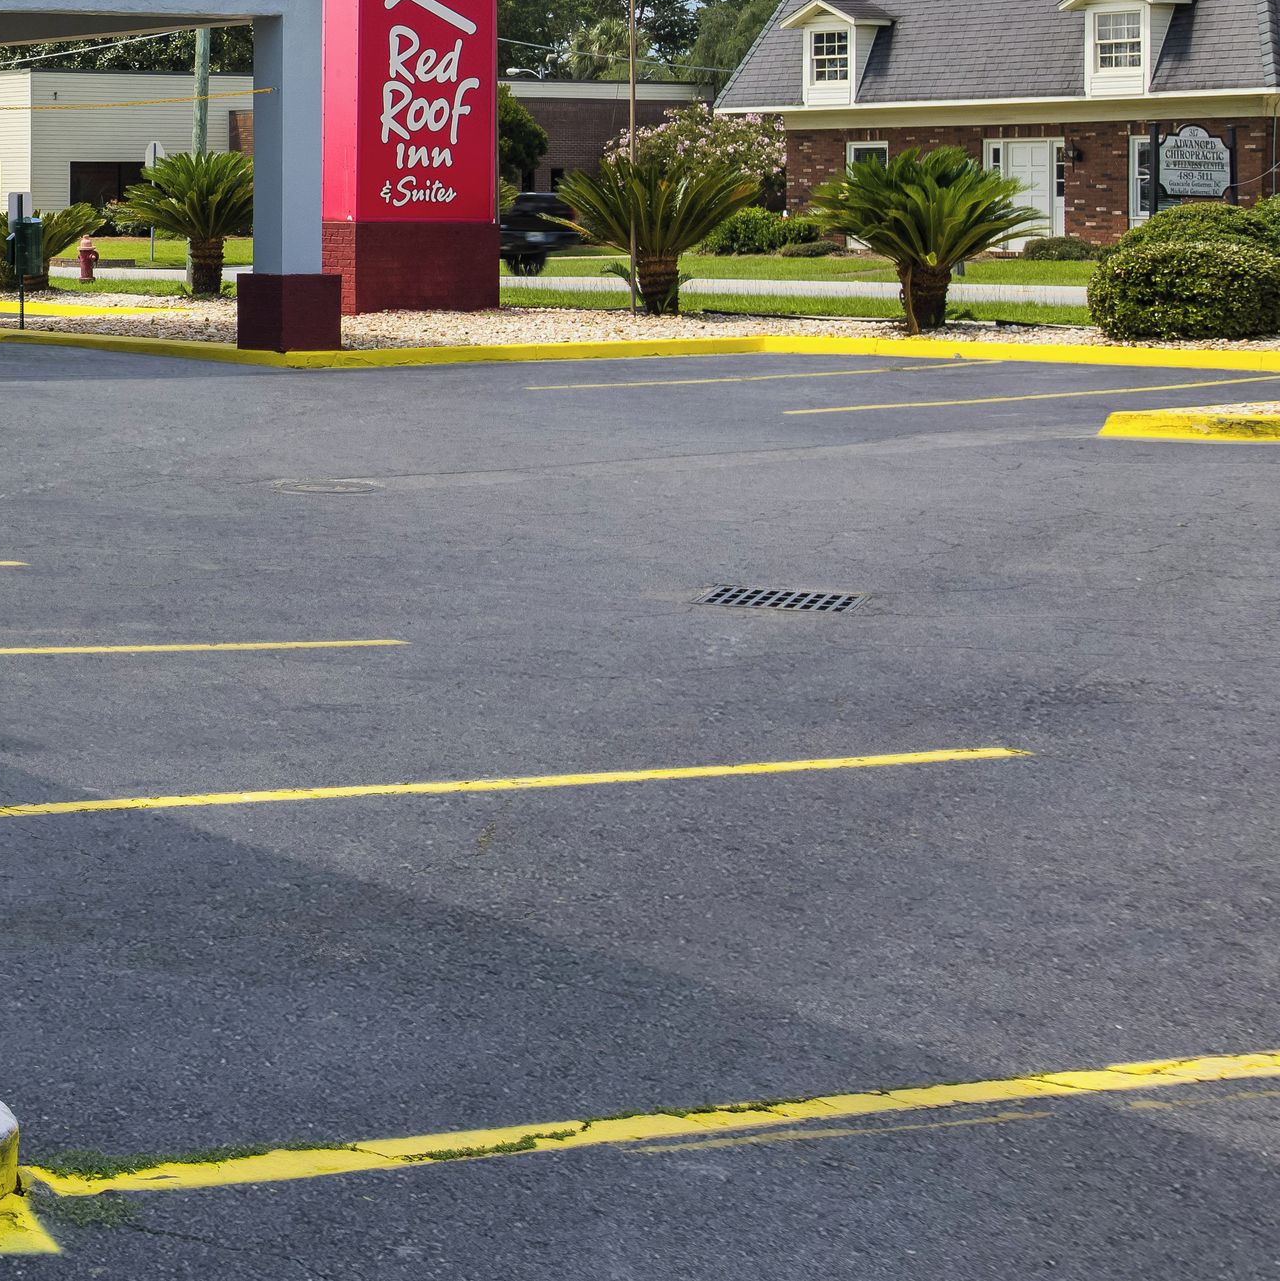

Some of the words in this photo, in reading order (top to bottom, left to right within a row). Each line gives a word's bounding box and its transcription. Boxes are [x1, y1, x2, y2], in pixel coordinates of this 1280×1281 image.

[389, 25, 463, 84] Red
[380, 77, 480, 145] Roof
[1188, 129, 1199, 137] 317
[1173, 139, 1216, 150] ADVANCED
[396, 142, 453, 169] Inn
[1165, 149, 1224, 161] CHIROPRACTIC
[1172, 160, 1203, 169] WELLNESS
[1203, 161, 1225, 170] CENTER
[1177, 172, 1213, 180] 489-5111
[380, 180, 392, 204] &
[392, 175, 457, 207] Suites
